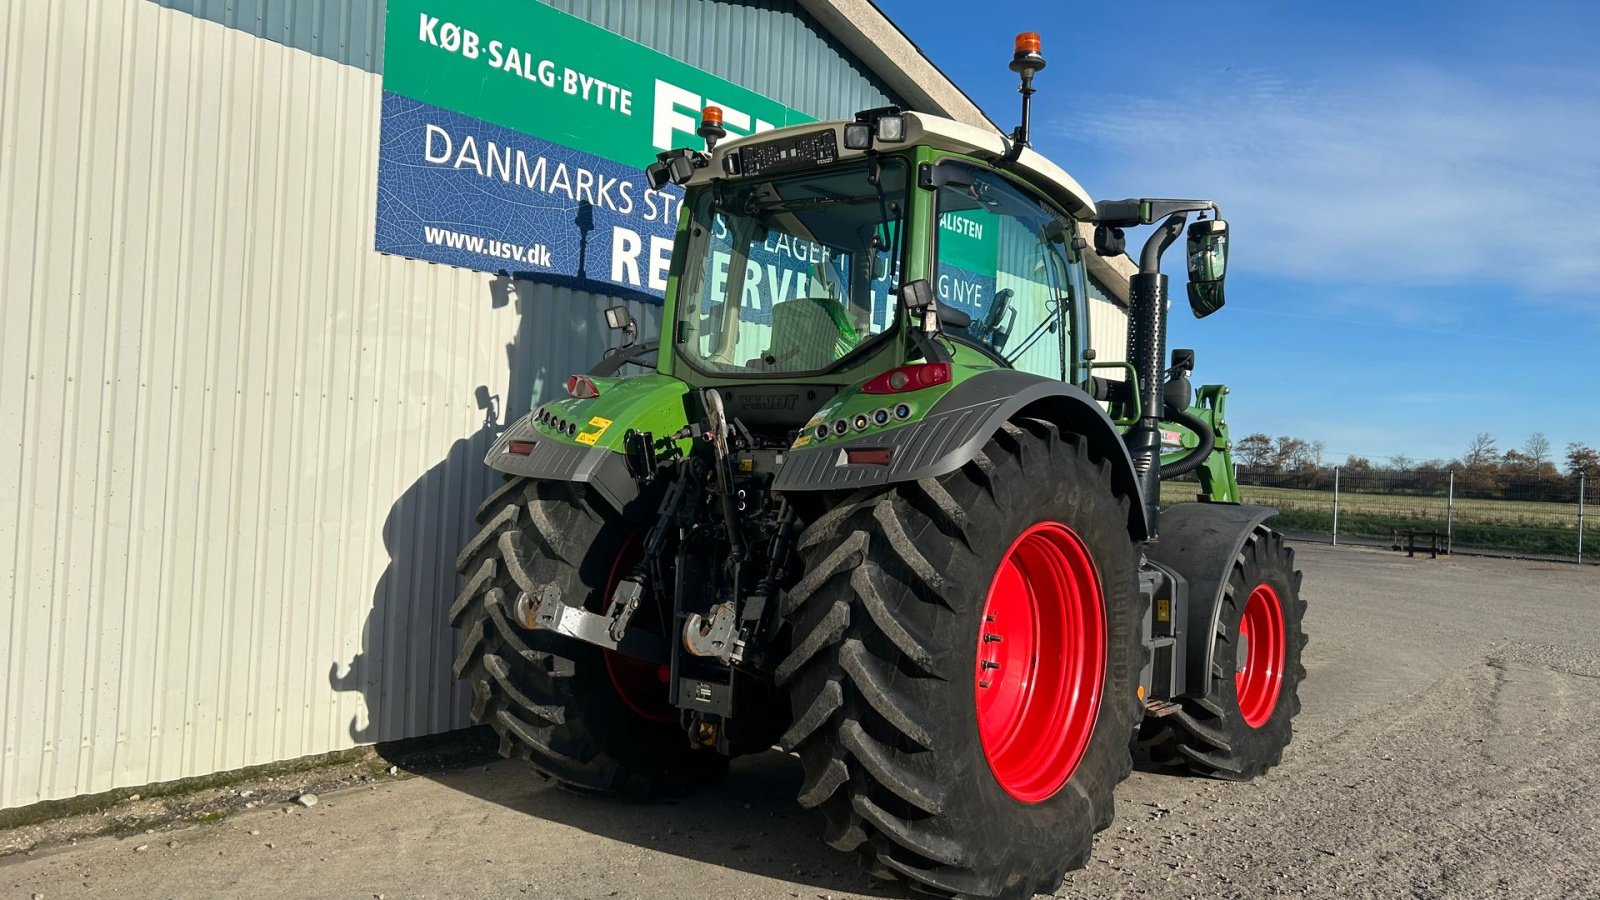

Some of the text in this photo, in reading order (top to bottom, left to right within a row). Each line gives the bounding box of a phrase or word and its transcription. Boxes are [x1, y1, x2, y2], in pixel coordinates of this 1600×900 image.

[424, 226, 552, 267] www.usv.dk
[425, 123, 634, 214] DANMARKS
[953, 279, 982, 307] NYE
